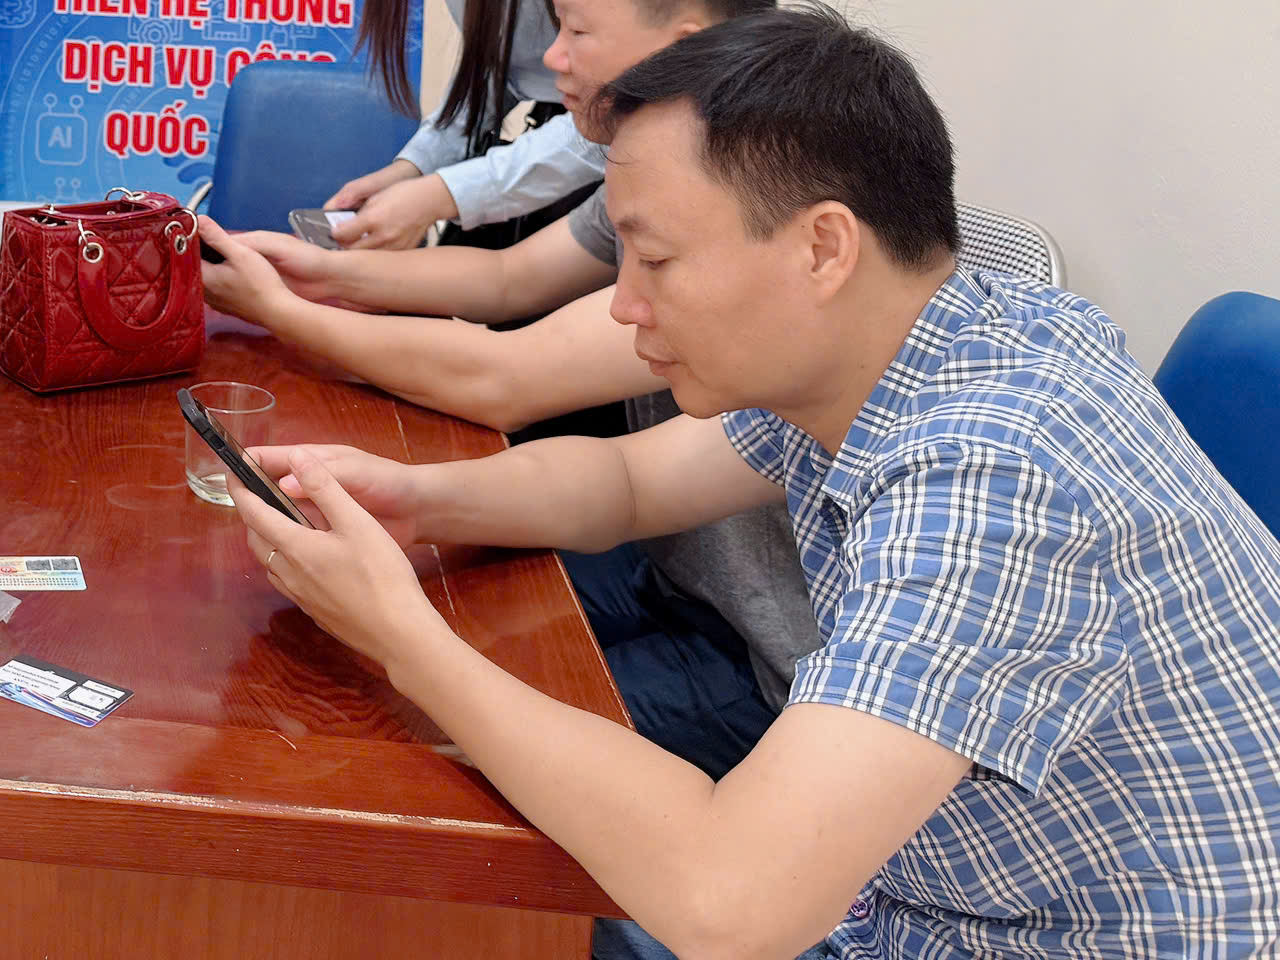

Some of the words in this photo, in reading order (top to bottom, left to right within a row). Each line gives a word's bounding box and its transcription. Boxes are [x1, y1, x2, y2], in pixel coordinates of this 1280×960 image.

[63, 41, 153, 92] DỊCH
[164, 46, 214, 97] VỤ
[48, 126, 72, 149] AI
[105, 101, 208, 157] QUỐC
